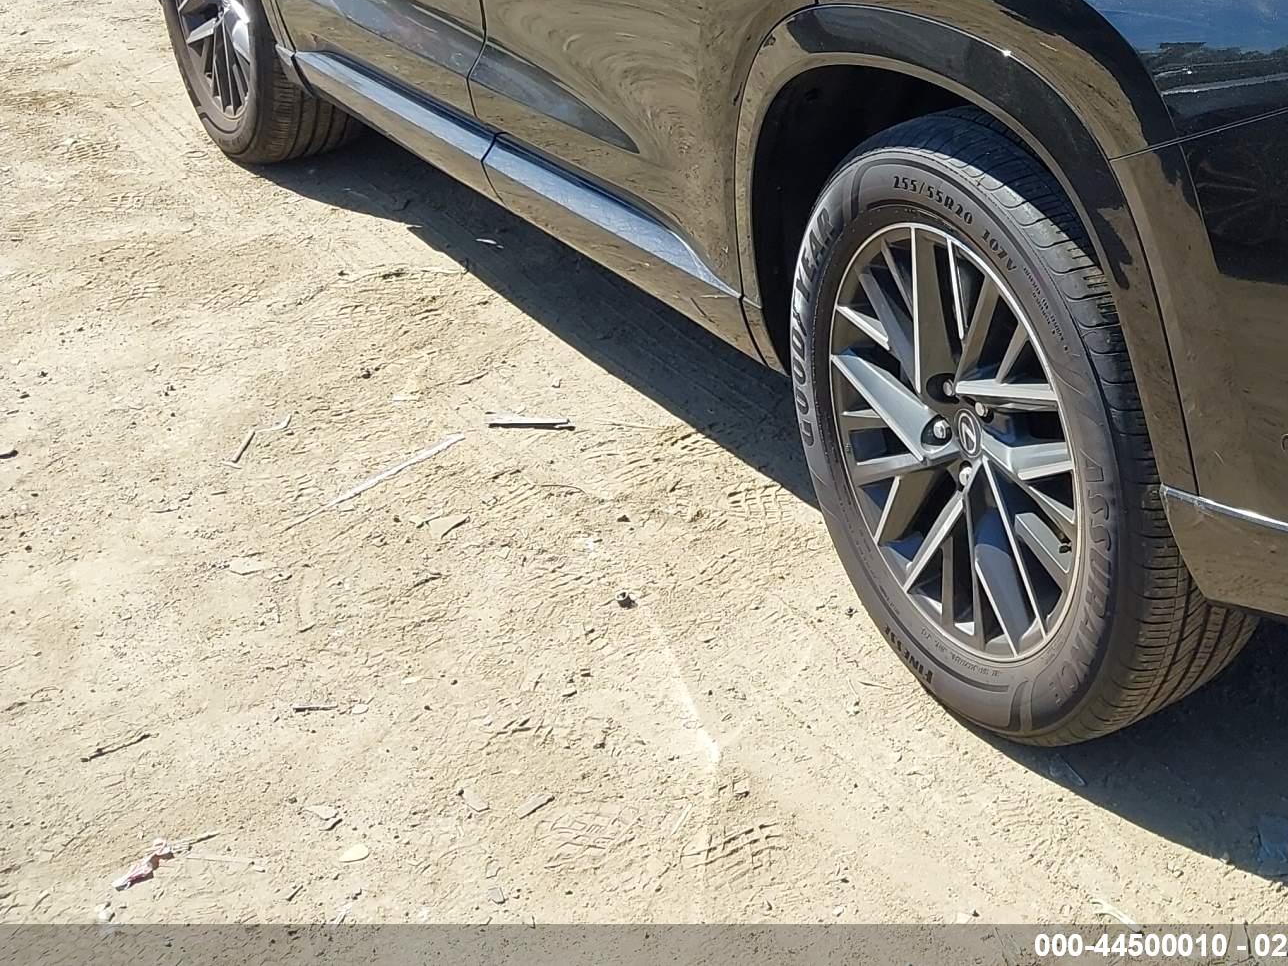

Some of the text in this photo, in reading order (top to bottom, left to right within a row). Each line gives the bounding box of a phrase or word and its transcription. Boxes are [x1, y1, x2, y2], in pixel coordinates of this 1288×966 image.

[892, 175, 974, 226] 255/55R20
[790, 206, 836, 448] GOODYEAR
[1048, 447, 1113, 708] ASSURANCE
